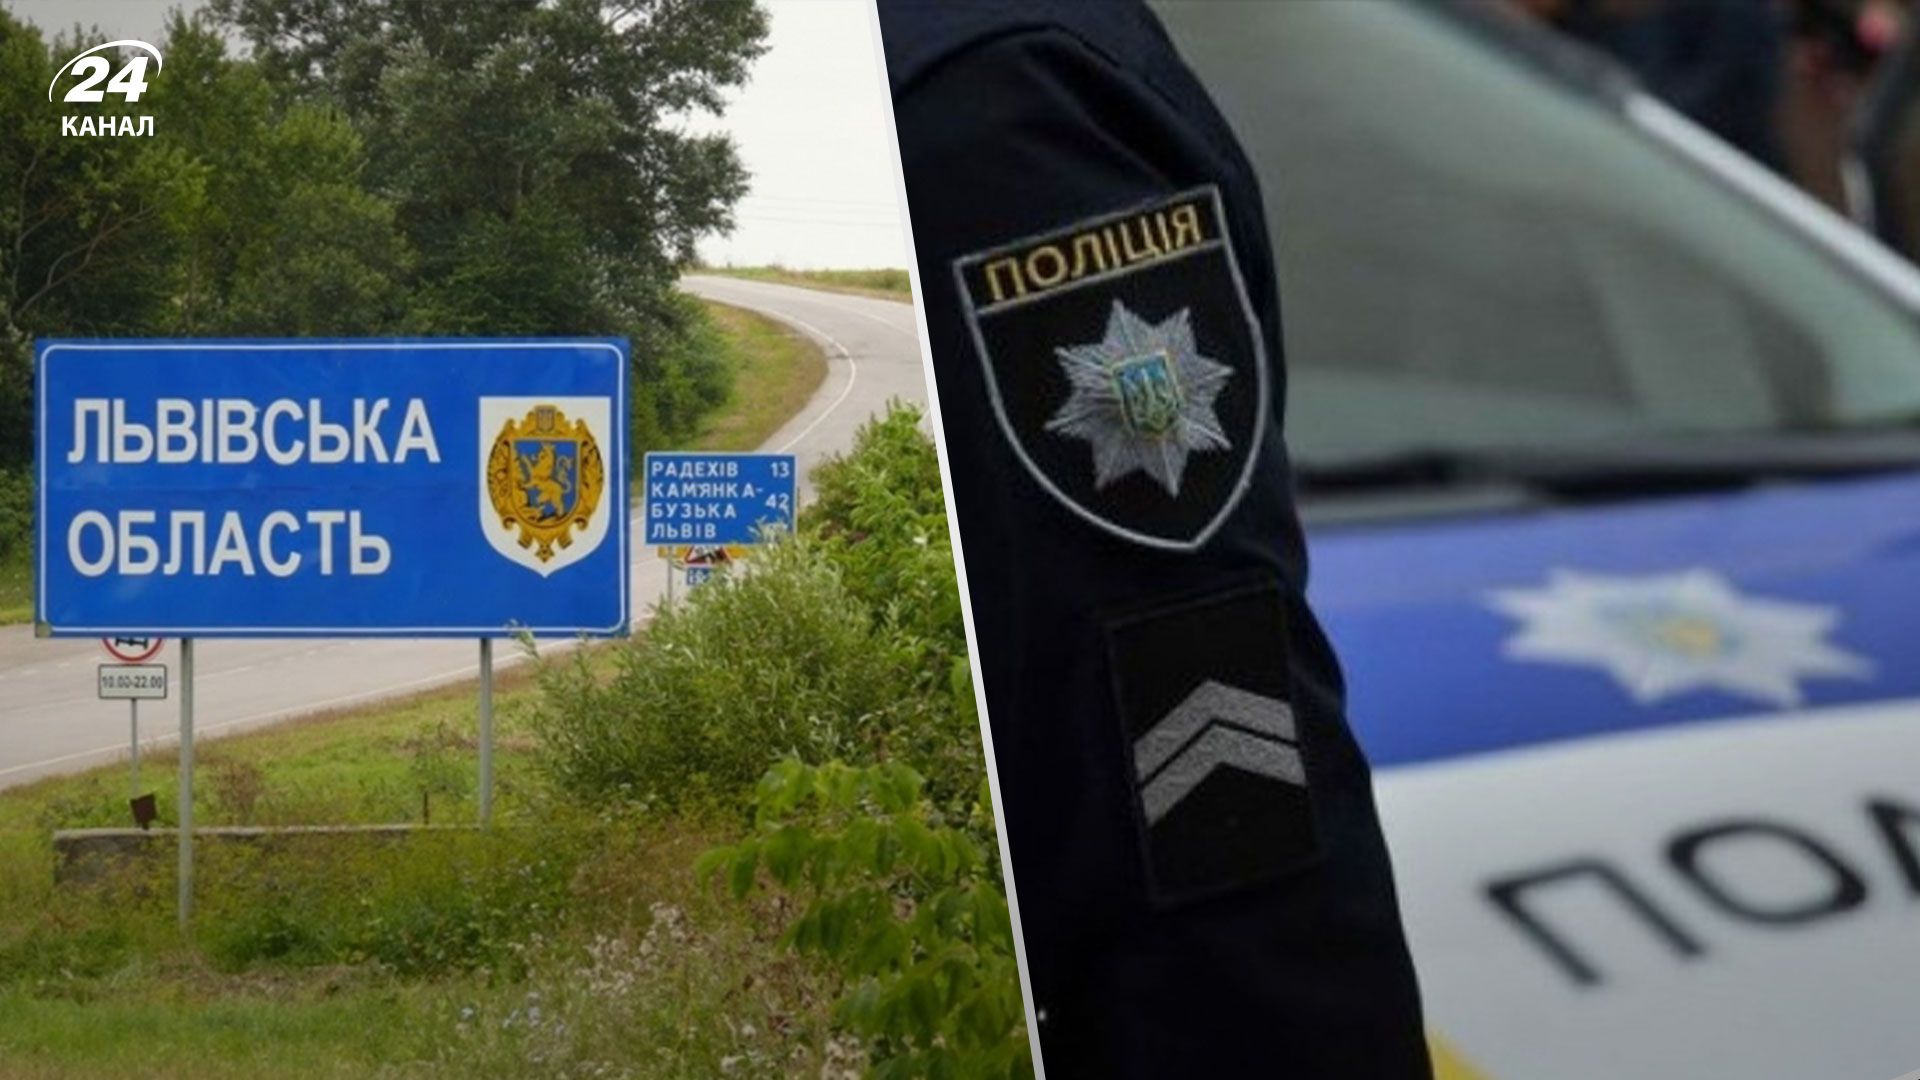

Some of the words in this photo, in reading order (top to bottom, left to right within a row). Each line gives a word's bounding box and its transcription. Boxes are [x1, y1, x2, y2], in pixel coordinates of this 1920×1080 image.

[984, 203, 1202, 302] ПОЛІЦІЯ
[67, 398, 442, 466] ЛЬВІВСЬКА
[651, 461, 739, 479] РАДЕХІВ
[770, 461, 791, 478] 13
[651, 503, 738, 519] БУЗЬКА
[764, 493, 791, 511] 42
[651, 522, 717, 540] ЛЬВІВ
[67, 510, 392, 577] ОБЛАСТЬ
